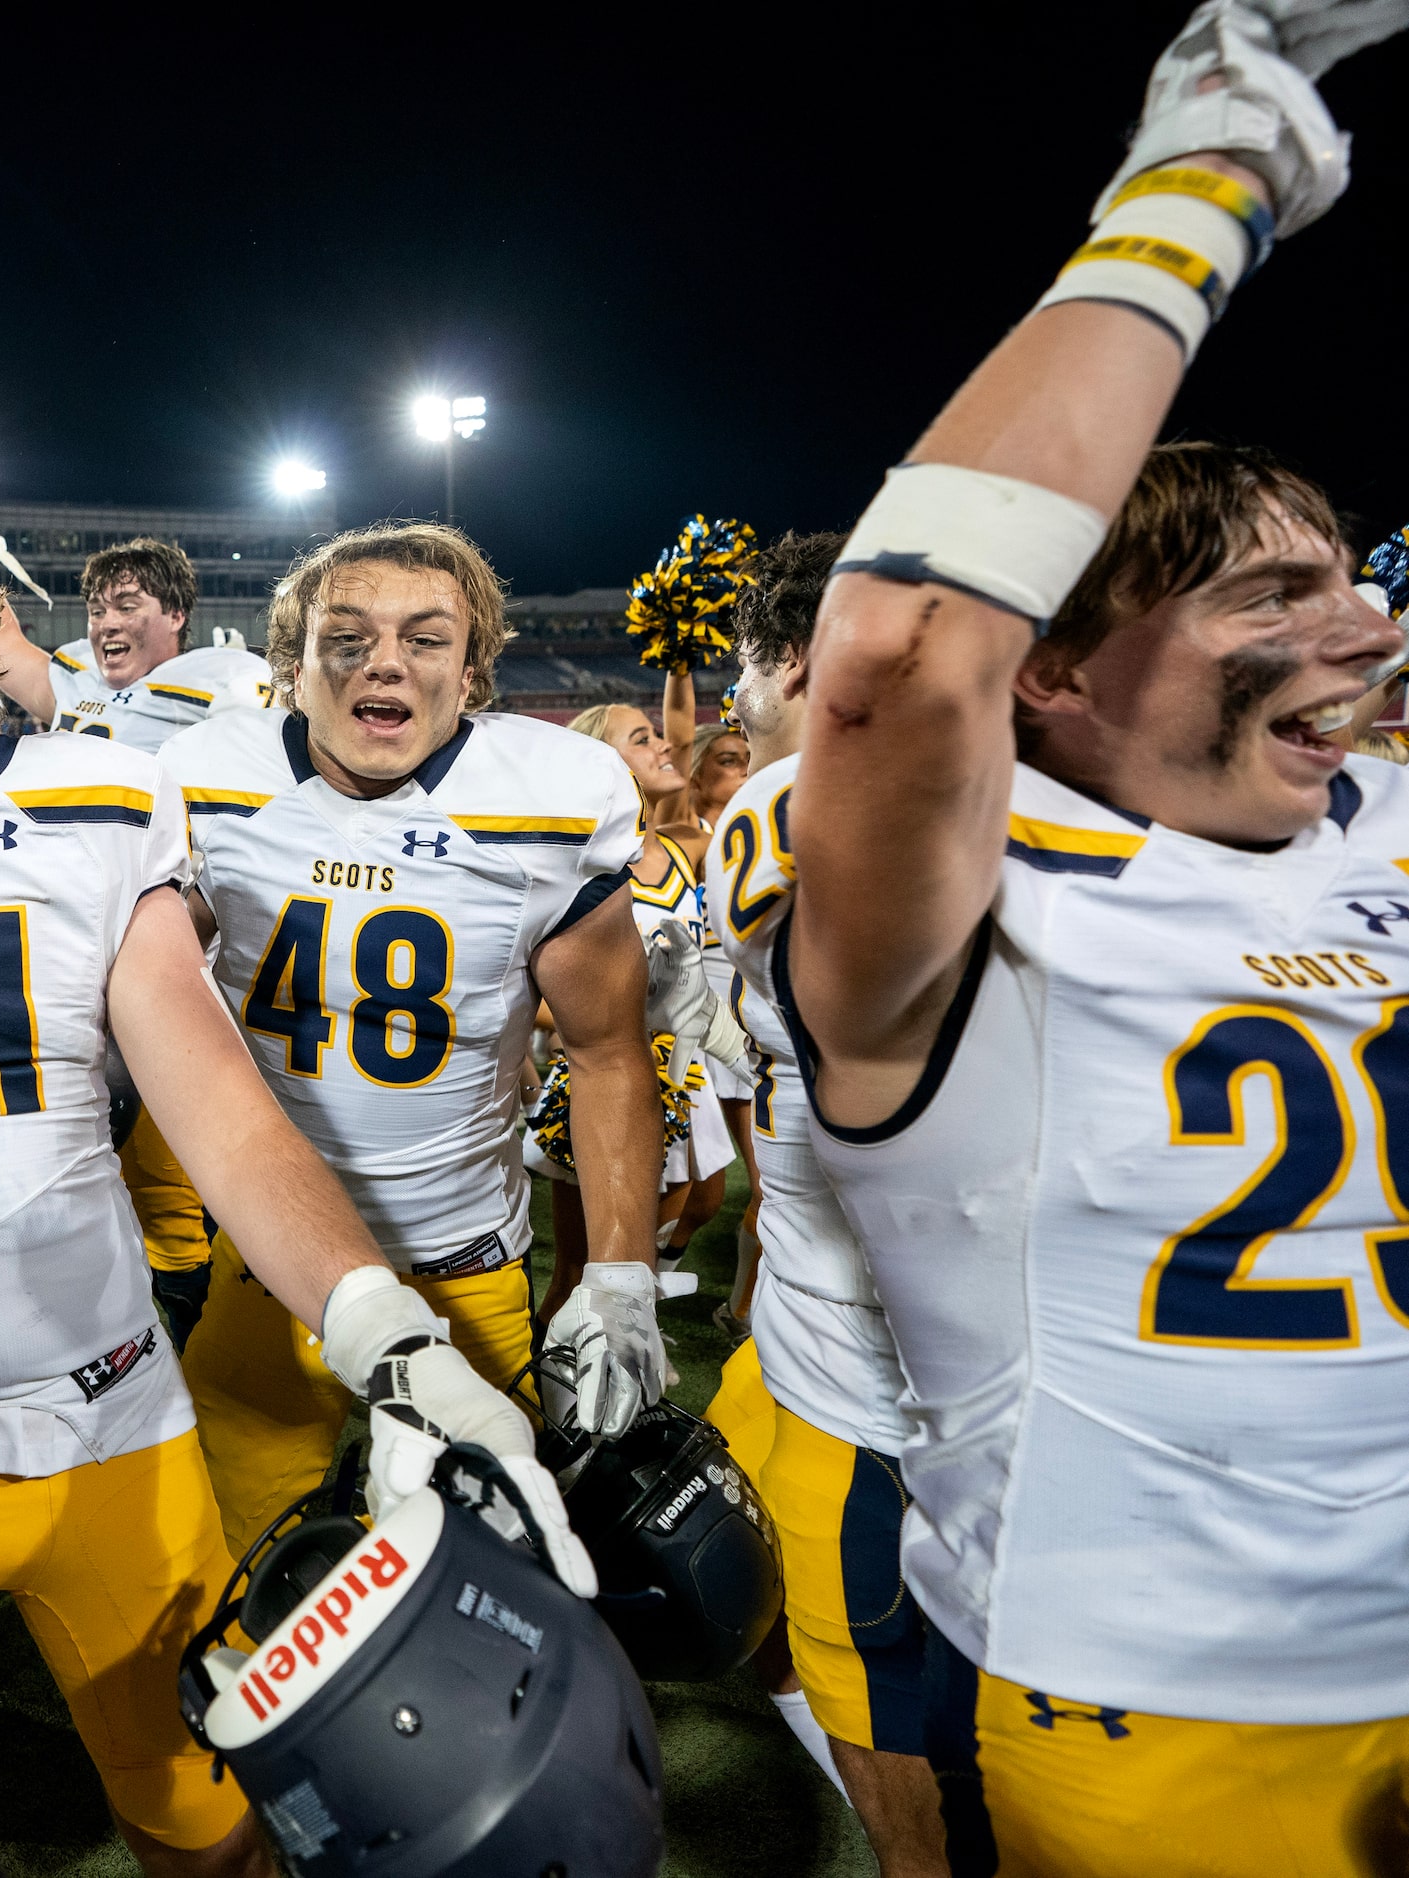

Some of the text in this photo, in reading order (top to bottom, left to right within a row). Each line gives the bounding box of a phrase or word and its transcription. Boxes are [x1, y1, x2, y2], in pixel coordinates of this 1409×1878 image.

[76, 700, 106, 716] SCOTS
[312, 860, 395, 892] SCOTS
[1243, 952, 1391, 989] SCOTS
[241, 895, 456, 1088] 48
[396, 1360, 412, 1401] COMBAT
[656, 1475, 708, 1531] Riddell
[238, 1536, 409, 1722] Riddell
